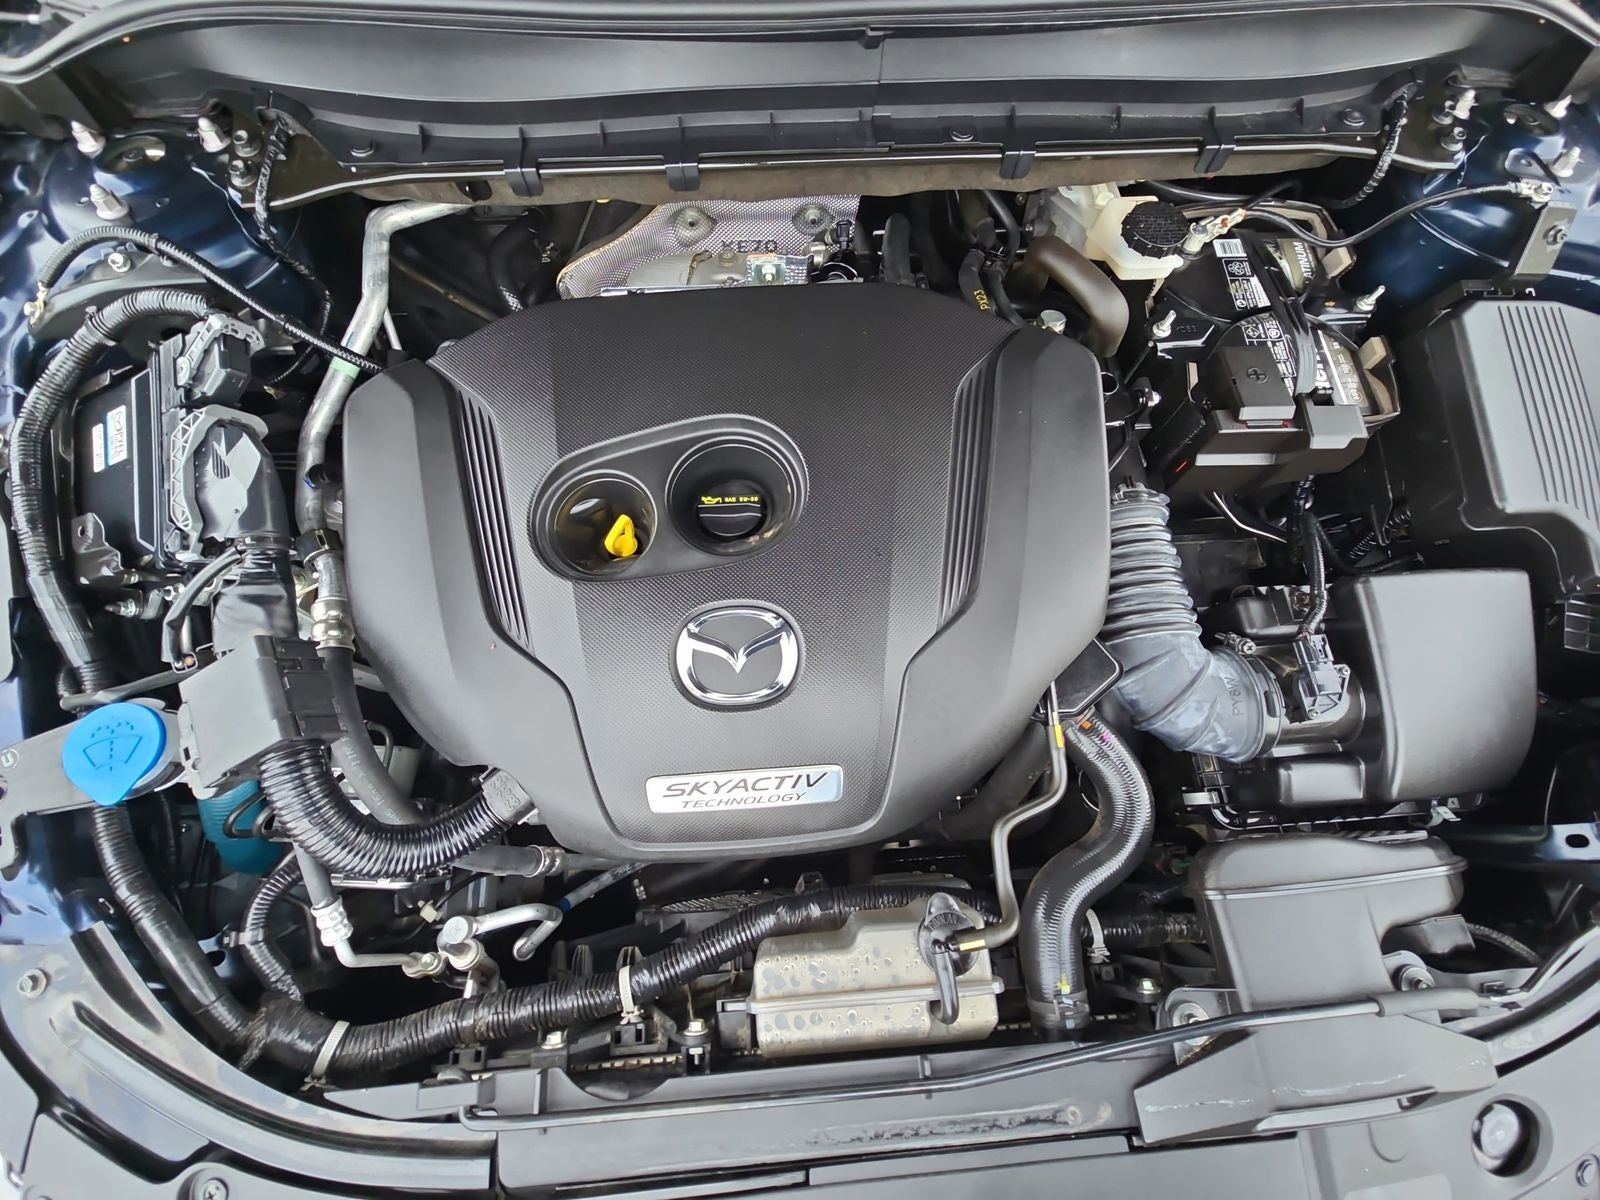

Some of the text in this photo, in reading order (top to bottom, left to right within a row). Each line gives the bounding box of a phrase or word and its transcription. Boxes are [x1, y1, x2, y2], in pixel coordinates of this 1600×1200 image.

[1292, 241, 1314, 284] ATINUM
[662, 772, 828, 798] SKYACTIV
[682, 792, 807, 809] TECHNOLOGY
